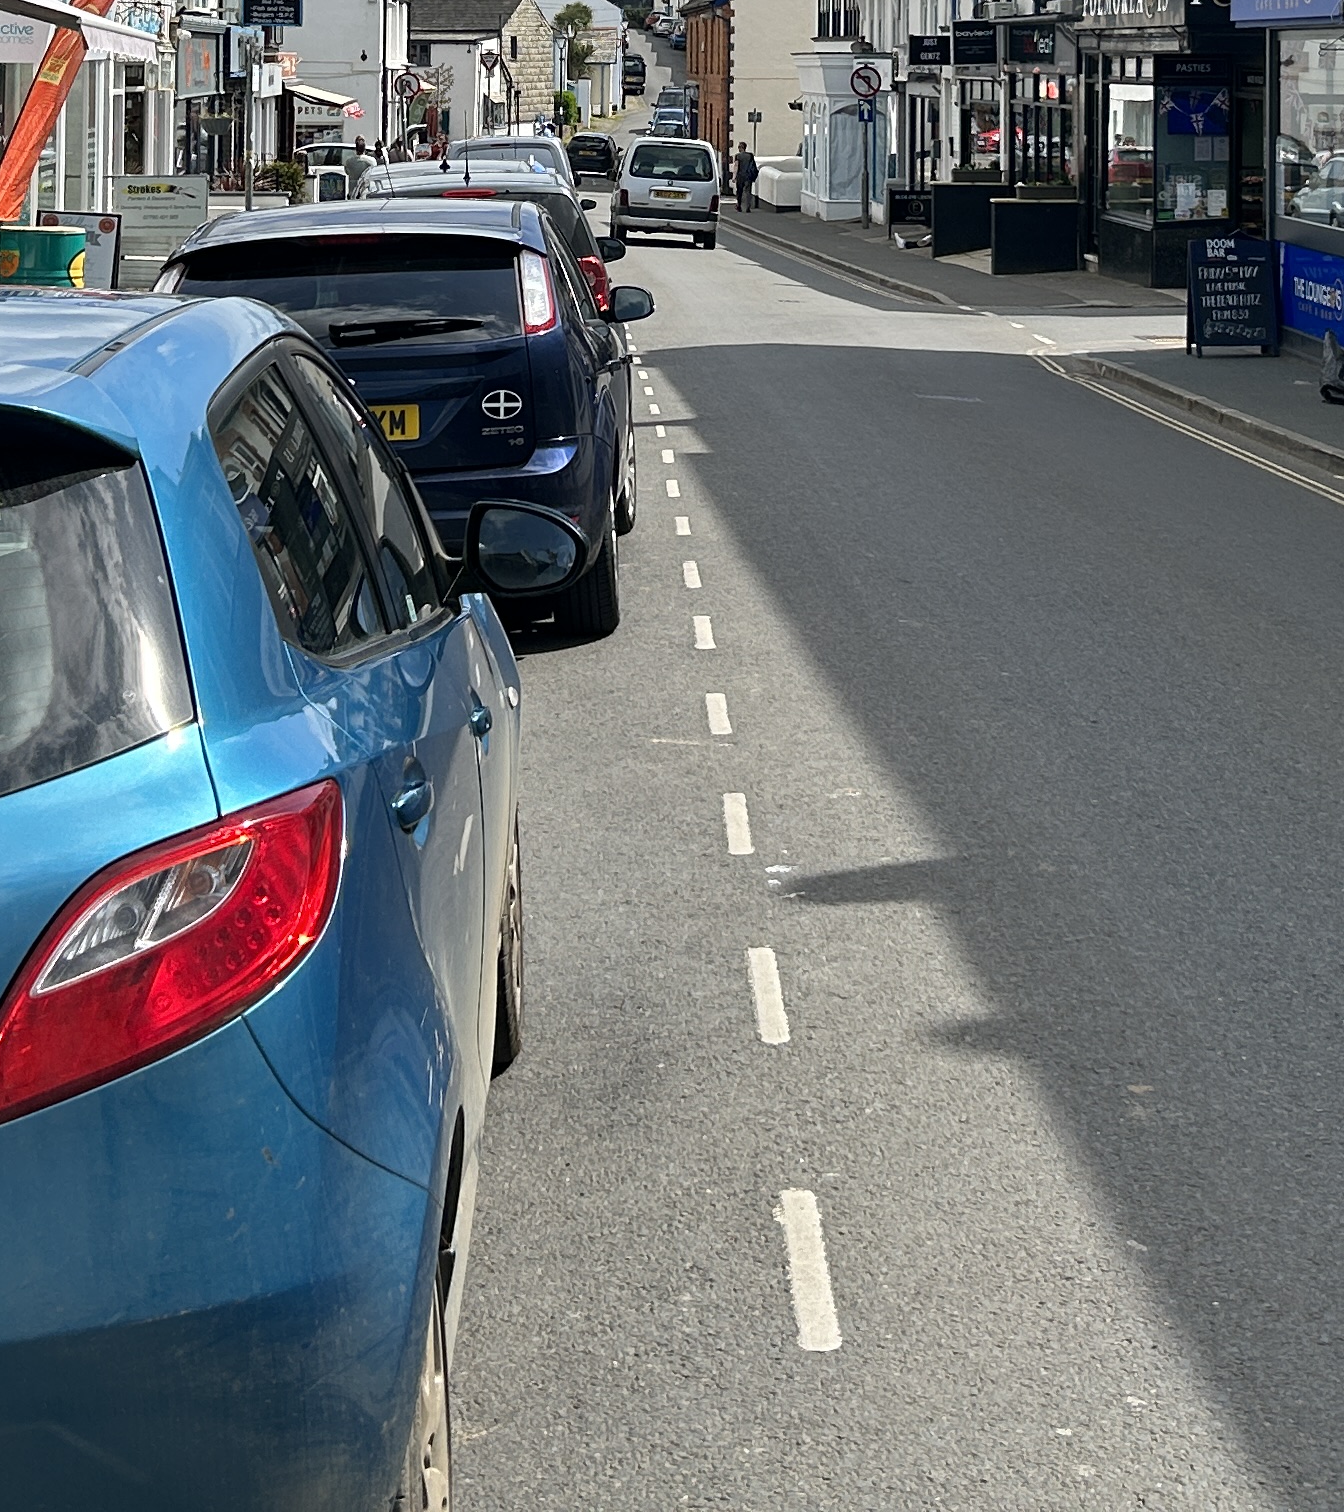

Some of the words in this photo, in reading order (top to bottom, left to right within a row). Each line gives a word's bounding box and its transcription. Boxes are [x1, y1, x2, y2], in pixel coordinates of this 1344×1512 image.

[1175, 63, 1211, 73] PASTIES
[297, 105, 323, 116] PETS
[127, 184, 162, 195] Strokes
[1205, 238, 1236, 249] DOOM
[1207, 248, 1226, 258] BAR
[482, 425, 525, 436] ZETEC
